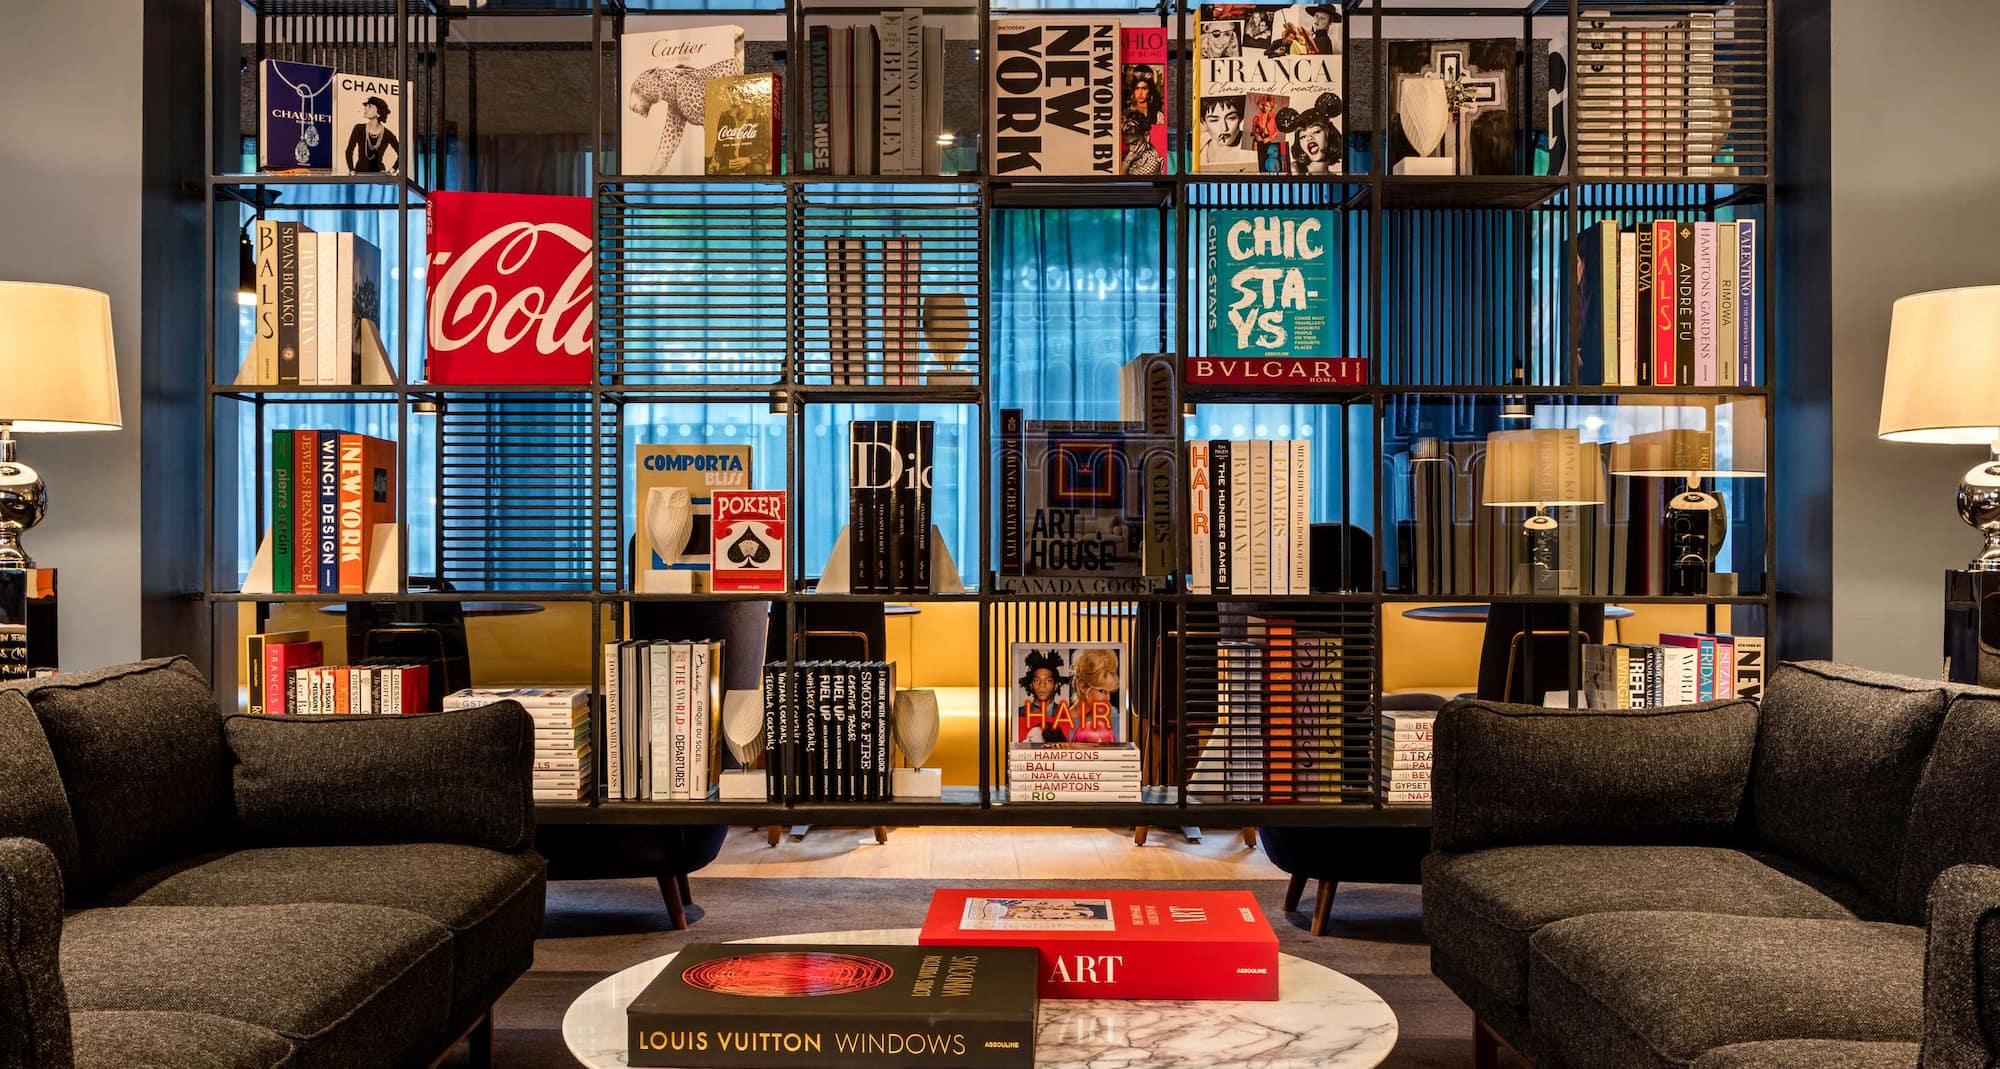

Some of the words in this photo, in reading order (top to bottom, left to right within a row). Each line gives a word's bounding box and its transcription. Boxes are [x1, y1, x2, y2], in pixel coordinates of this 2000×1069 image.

[651, 39, 707, 58] Cartier
[908, 15, 919, 90] VALENTINO
[1093, 25, 1113, 72] NEW
[342, 78, 400, 97] CHANE
[1045, 25, 1091, 135] NEW
[1208, 59, 1335, 83] FRANCA
[1250, 82, 1275, 93] and
[883, 52, 901, 156] BENTLEY
[996, 26, 1043, 174] YORK
[1093, 76, 1114, 139] YORK
[814, 123, 829, 168] MUSE
[1093, 144, 1113, 174] BY
[281, 227, 295, 269] SEVAN
[1208, 225, 1217, 268] CHIC
[1227, 216, 1323, 261] CHIC
[1639, 231, 1651, 291] BULOVA
[1658, 228, 1672, 331] BALS
[1700, 228, 1711, 297] HAMPTONS
[1741, 229, 1752, 296] VALENTINO
[259, 226, 274, 340] BALS
[280, 273, 295, 327] BIÇAKÇI
[1208, 274, 1217, 330] STAYS
[1680, 263, 1692, 315] ANDRÉ
[1722, 280, 1731, 326] RIMOWA
[1228, 307, 1288, 350] YS
[1680, 321, 1692, 341] FU
[1700, 301, 1711, 360] GARDENS
[1196, 361, 1348, 377] BVLGARI
[302, 435, 312, 483] JEWELS
[322, 439, 335, 496] WINCH
[342, 448, 361, 495] NEW
[643, 454, 743, 472] COMPORTA
[705, 472, 744, 486] BLISS
[1218, 463, 1226, 486] THE
[276, 468, 290, 509] pierre
[718, 496, 781, 521] POKER
[1153, 474, 1170, 543] CITIES
[1192, 446, 1209, 534] HAIR
[1234, 457, 1247, 552] RAJASTHAN
[1253, 456, 1267, 539] OTTOMAN
[1273, 458, 1287, 537] FLOWERS
[322, 503, 335, 564] DESIGN
[342, 499, 362, 562] YORK
[1032, 508, 1080, 539] ART
[1218, 489, 1226, 538] HUNGER
[277, 513, 289, 556] cardin
[302, 488, 312, 582] RENAISSANCE
[1031, 540, 1117, 571] HOUSE
[1218, 542, 1227, 583] GAMES
[1253, 543, 1267, 583] CHIC
[1005, 578, 1083, 594] CANADA
[270, 650, 279, 705] FRANCIS
[676, 665, 686, 686] THE
[1630, 663, 1645, 708] REFLE
[1700, 645, 1713, 685] FRIDA
[1720, 653, 1730, 696] SUZAN
[676, 690, 686, 725] WORLD
[765, 673, 775, 709] TEQUILA
[819, 675, 831, 702] FUEL
[833, 675, 845, 702] FUEL
[847, 674, 857, 712] CREATIVE
[861, 671, 872, 719] SMOKE
[696, 728, 702, 738] DU
[766, 711, 775, 750] COCKTAILS
[779, 706, 788, 744] COCKTAILS
[806, 712, 817, 753] COCKTAILS
[820, 705, 832, 721] UP
[834, 705, 846, 721] UP
[848, 715, 857, 742] TABLES
[861, 722, 871, 731] &
[1025, 700, 1112, 730] HAIR
[675, 734, 685, 788] DEPARTURES
[861, 733, 872, 770] FIRE
[1026, 762, 1056, 771] BALI
[1034, 751, 1099, 760] HAMPTONS
[1031, 772, 1060, 780] NAPA
[1063, 772, 1102, 780] VALLEY
[1032, 792, 1056, 801] RIO
[1034, 782, 1100, 791] HAMPTONS
[1395, 782, 1427, 790] GYPSET
[941, 955, 979, 998] WINDOWS
[1048, 955, 1123, 984] ART
[639, 1031, 708, 1050] LOUIS
[718, 1032, 821, 1053] VUITTON
[834, 1032, 966, 1055] WINDOWS
[984, 1041, 1020, 1049] ASSOULINE
